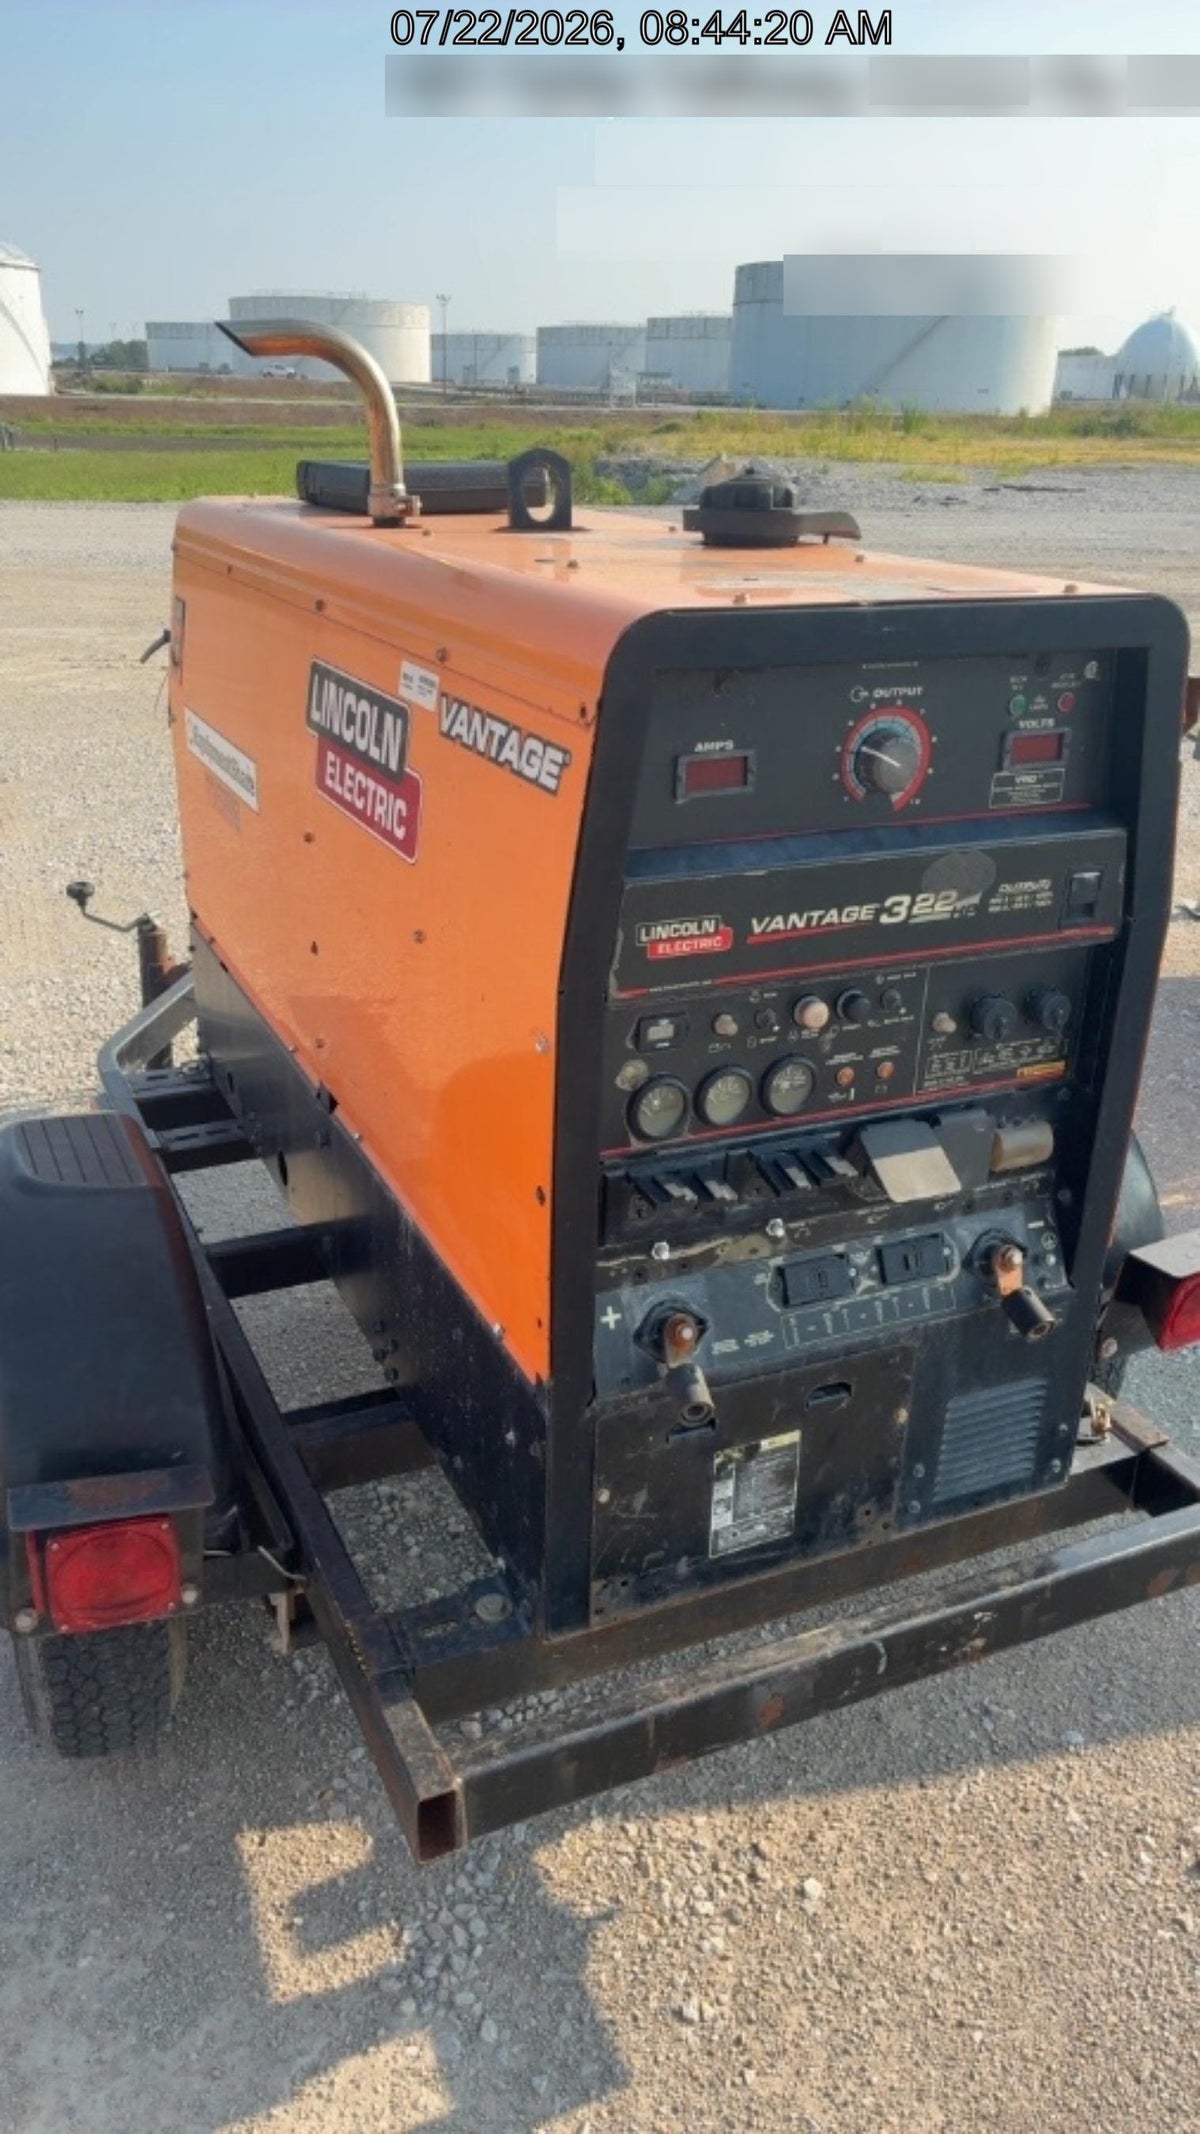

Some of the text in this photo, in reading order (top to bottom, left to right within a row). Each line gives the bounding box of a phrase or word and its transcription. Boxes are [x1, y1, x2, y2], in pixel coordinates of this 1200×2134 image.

[872, 686, 923, 699] OUTPUT
[310, 673, 403, 773] LINCOLN
[694, 739, 734, 752] AMPS
[324, 750, 407, 840] ELECTRIC
[751, 905, 876, 934] VANTAGE
[878, 889, 958, 925] 322
[639, 919, 716, 943] LINCOLN
[657, 936, 722, 954] ELECTRIC
